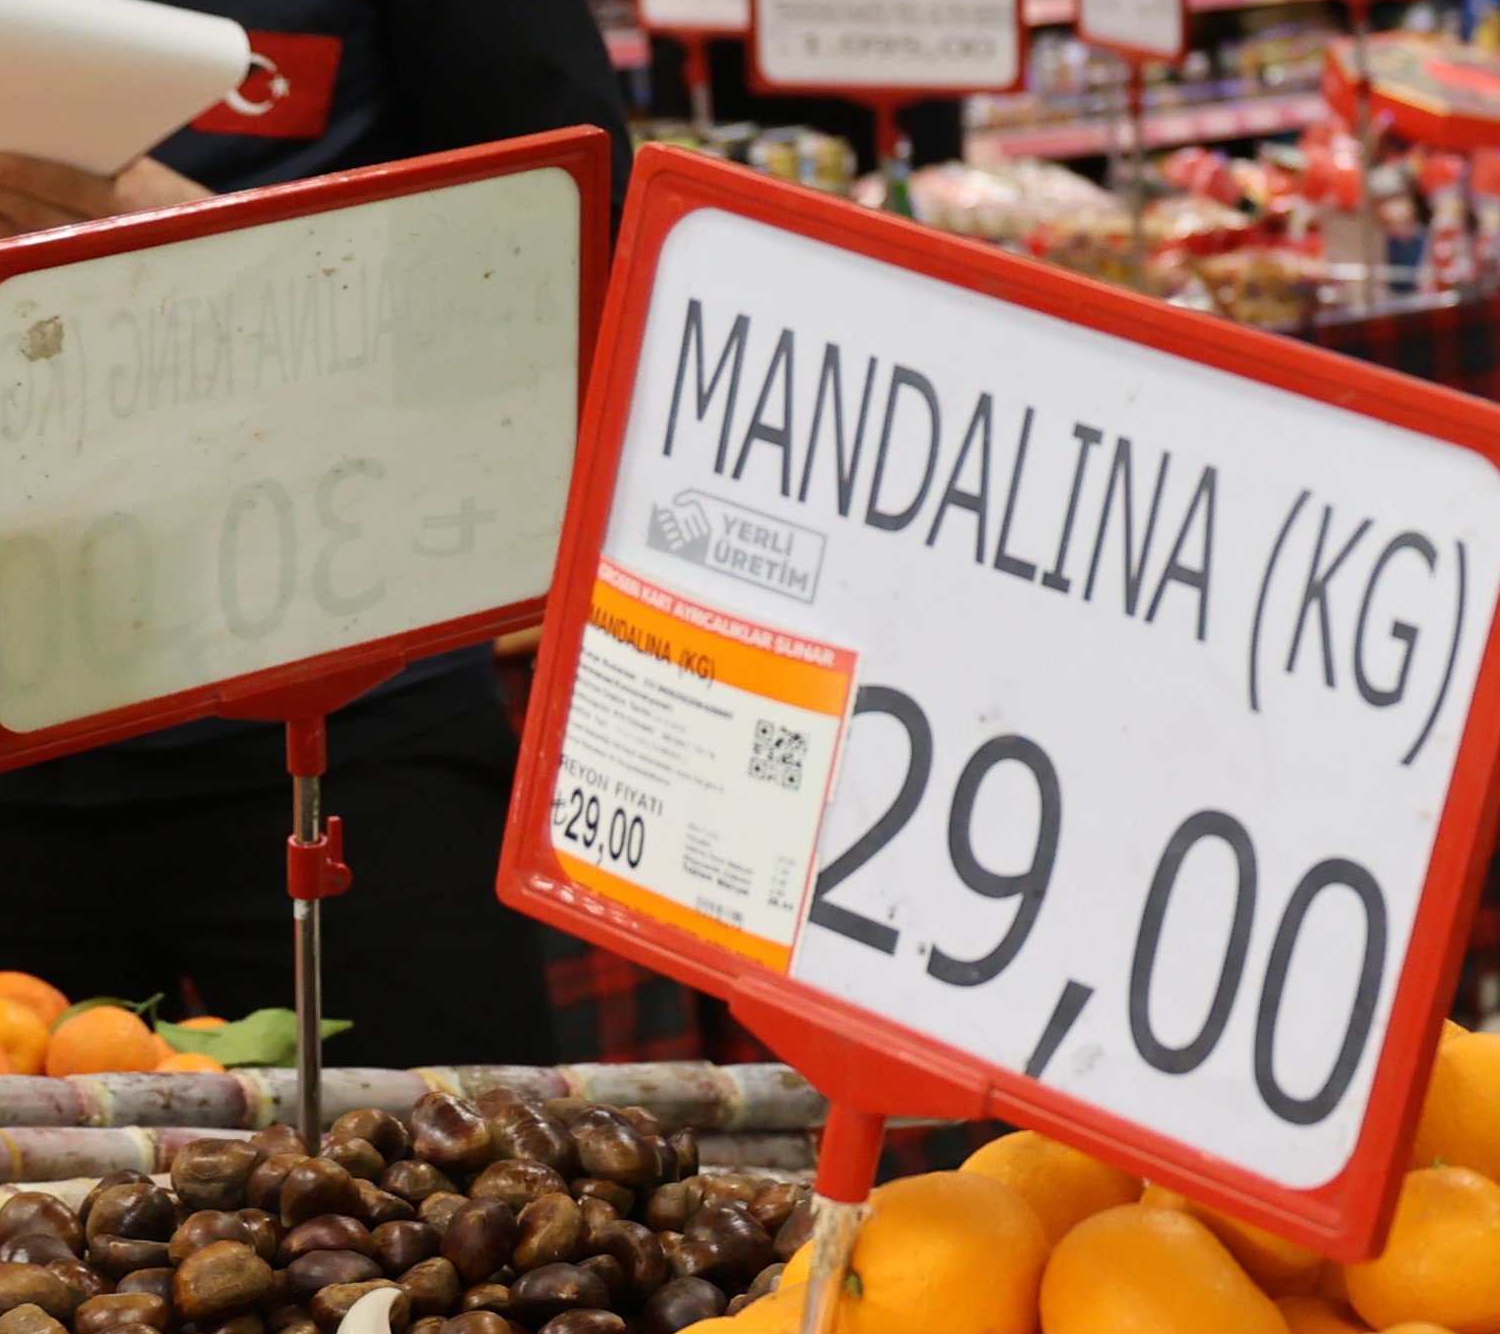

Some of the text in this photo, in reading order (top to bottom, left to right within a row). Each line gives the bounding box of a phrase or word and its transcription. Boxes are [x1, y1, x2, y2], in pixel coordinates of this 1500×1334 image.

[663, 299, 1470, 767] MANDALINA (KG)
[720, 513, 796, 557] YERLİ
[712, 539, 811, 592] ÜRETİM
[678, 646, 717, 690] (KG)
[806, 686, 1389, 1127] 29,00
